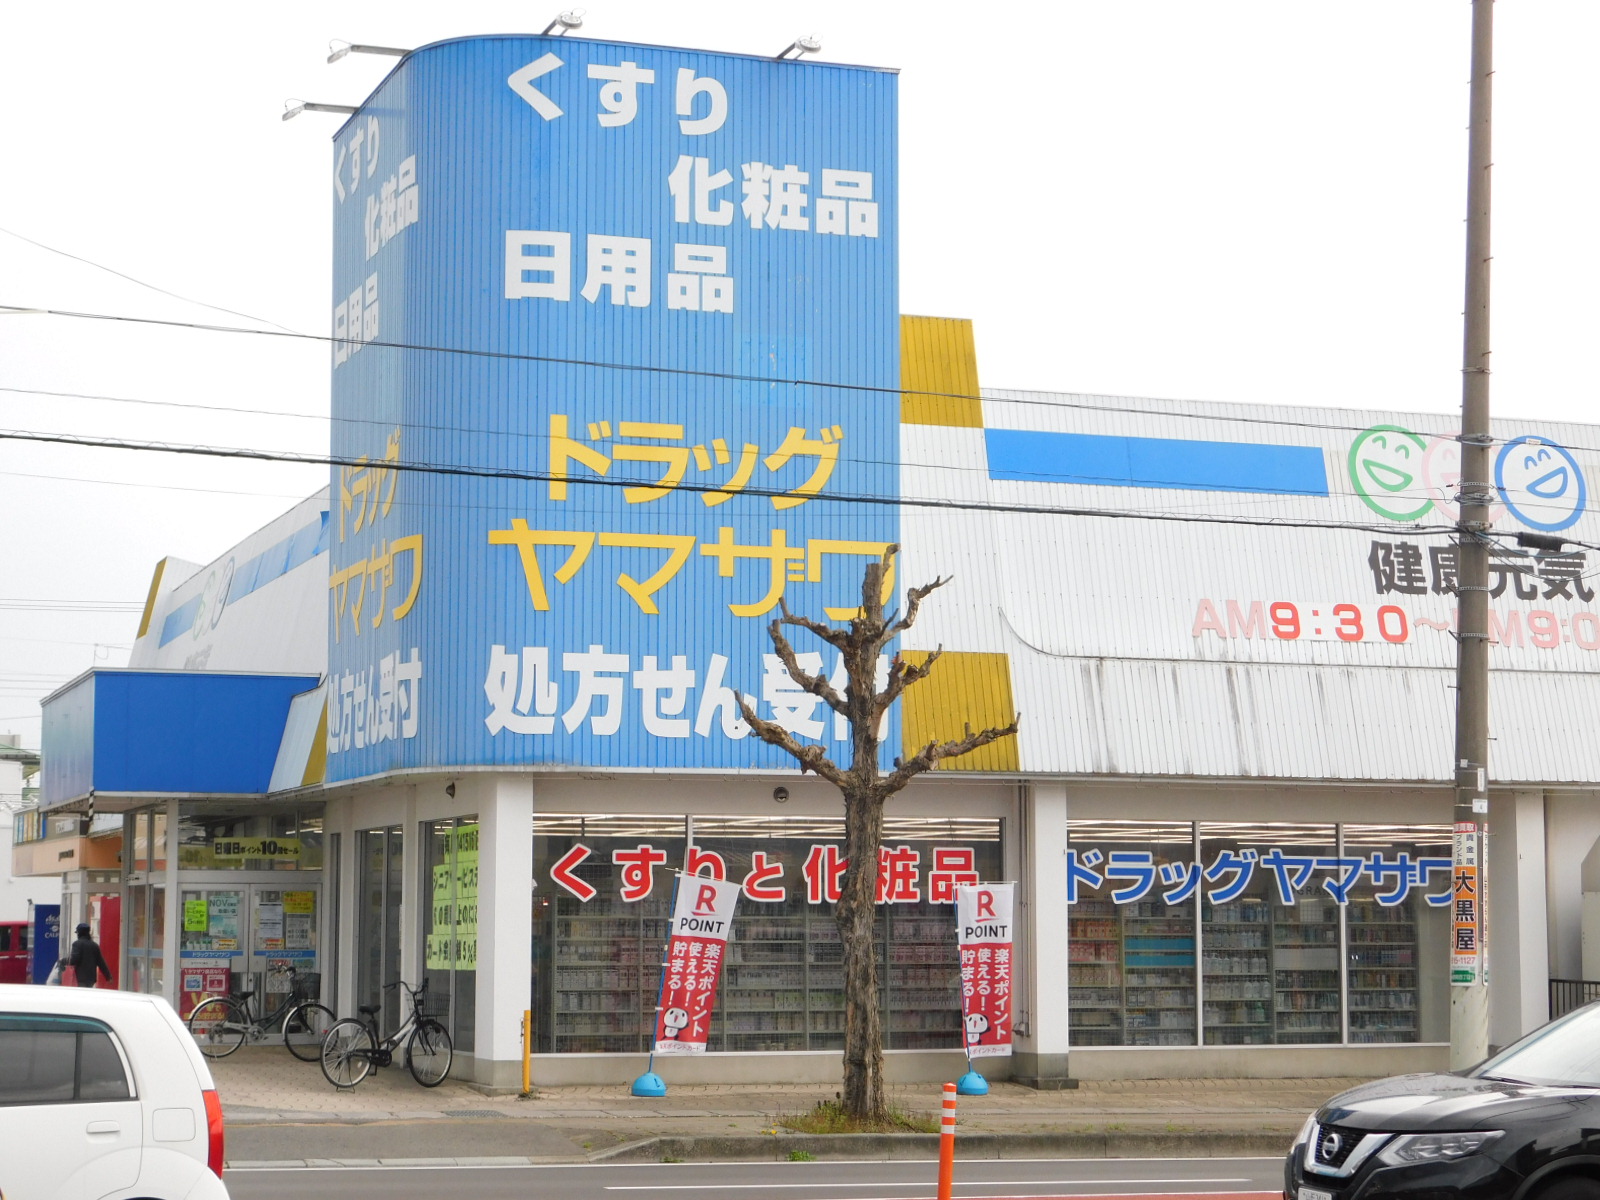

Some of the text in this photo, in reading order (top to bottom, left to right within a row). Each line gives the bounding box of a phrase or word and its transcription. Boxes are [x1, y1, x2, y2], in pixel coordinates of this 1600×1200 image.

[507, 52, 728, 135] くすり
[334, 115, 380, 204] くすり
[668, 155, 879, 238] 化粧品
[365, 154, 419, 262] 化粧品
[504, 229, 734, 314] 日用品
[334, 270, 379, 370] 日用品
[339, 426, 401, 543] ドラッグ
[549, 413, 844, 510] ドラッグ
[329, 533, 423, 644] ヤマザワ
[488, 518, 898, 621] ヤマザワ
[550, 843, 980, 905] くすりと化粧品
[1466, 834, 1474, 865] 貴金属
[680, 917, 724, 934] POINT
[695, 884, 717, 914] R
[966, 925, 1008, 939] POINT
[977, 890, 996, 918] R
[1455, 870, 1475, 950] 大黒屋
[668, 941, 687, 1006] 貯まる！
[684, 942, 703, 1007] 使える！
[693, 943, 721, 1038] 楽天ポイント
[976, 948, 991, 1011] 使える！
[994, 948, 1010, 1040] 楽天ポイント
